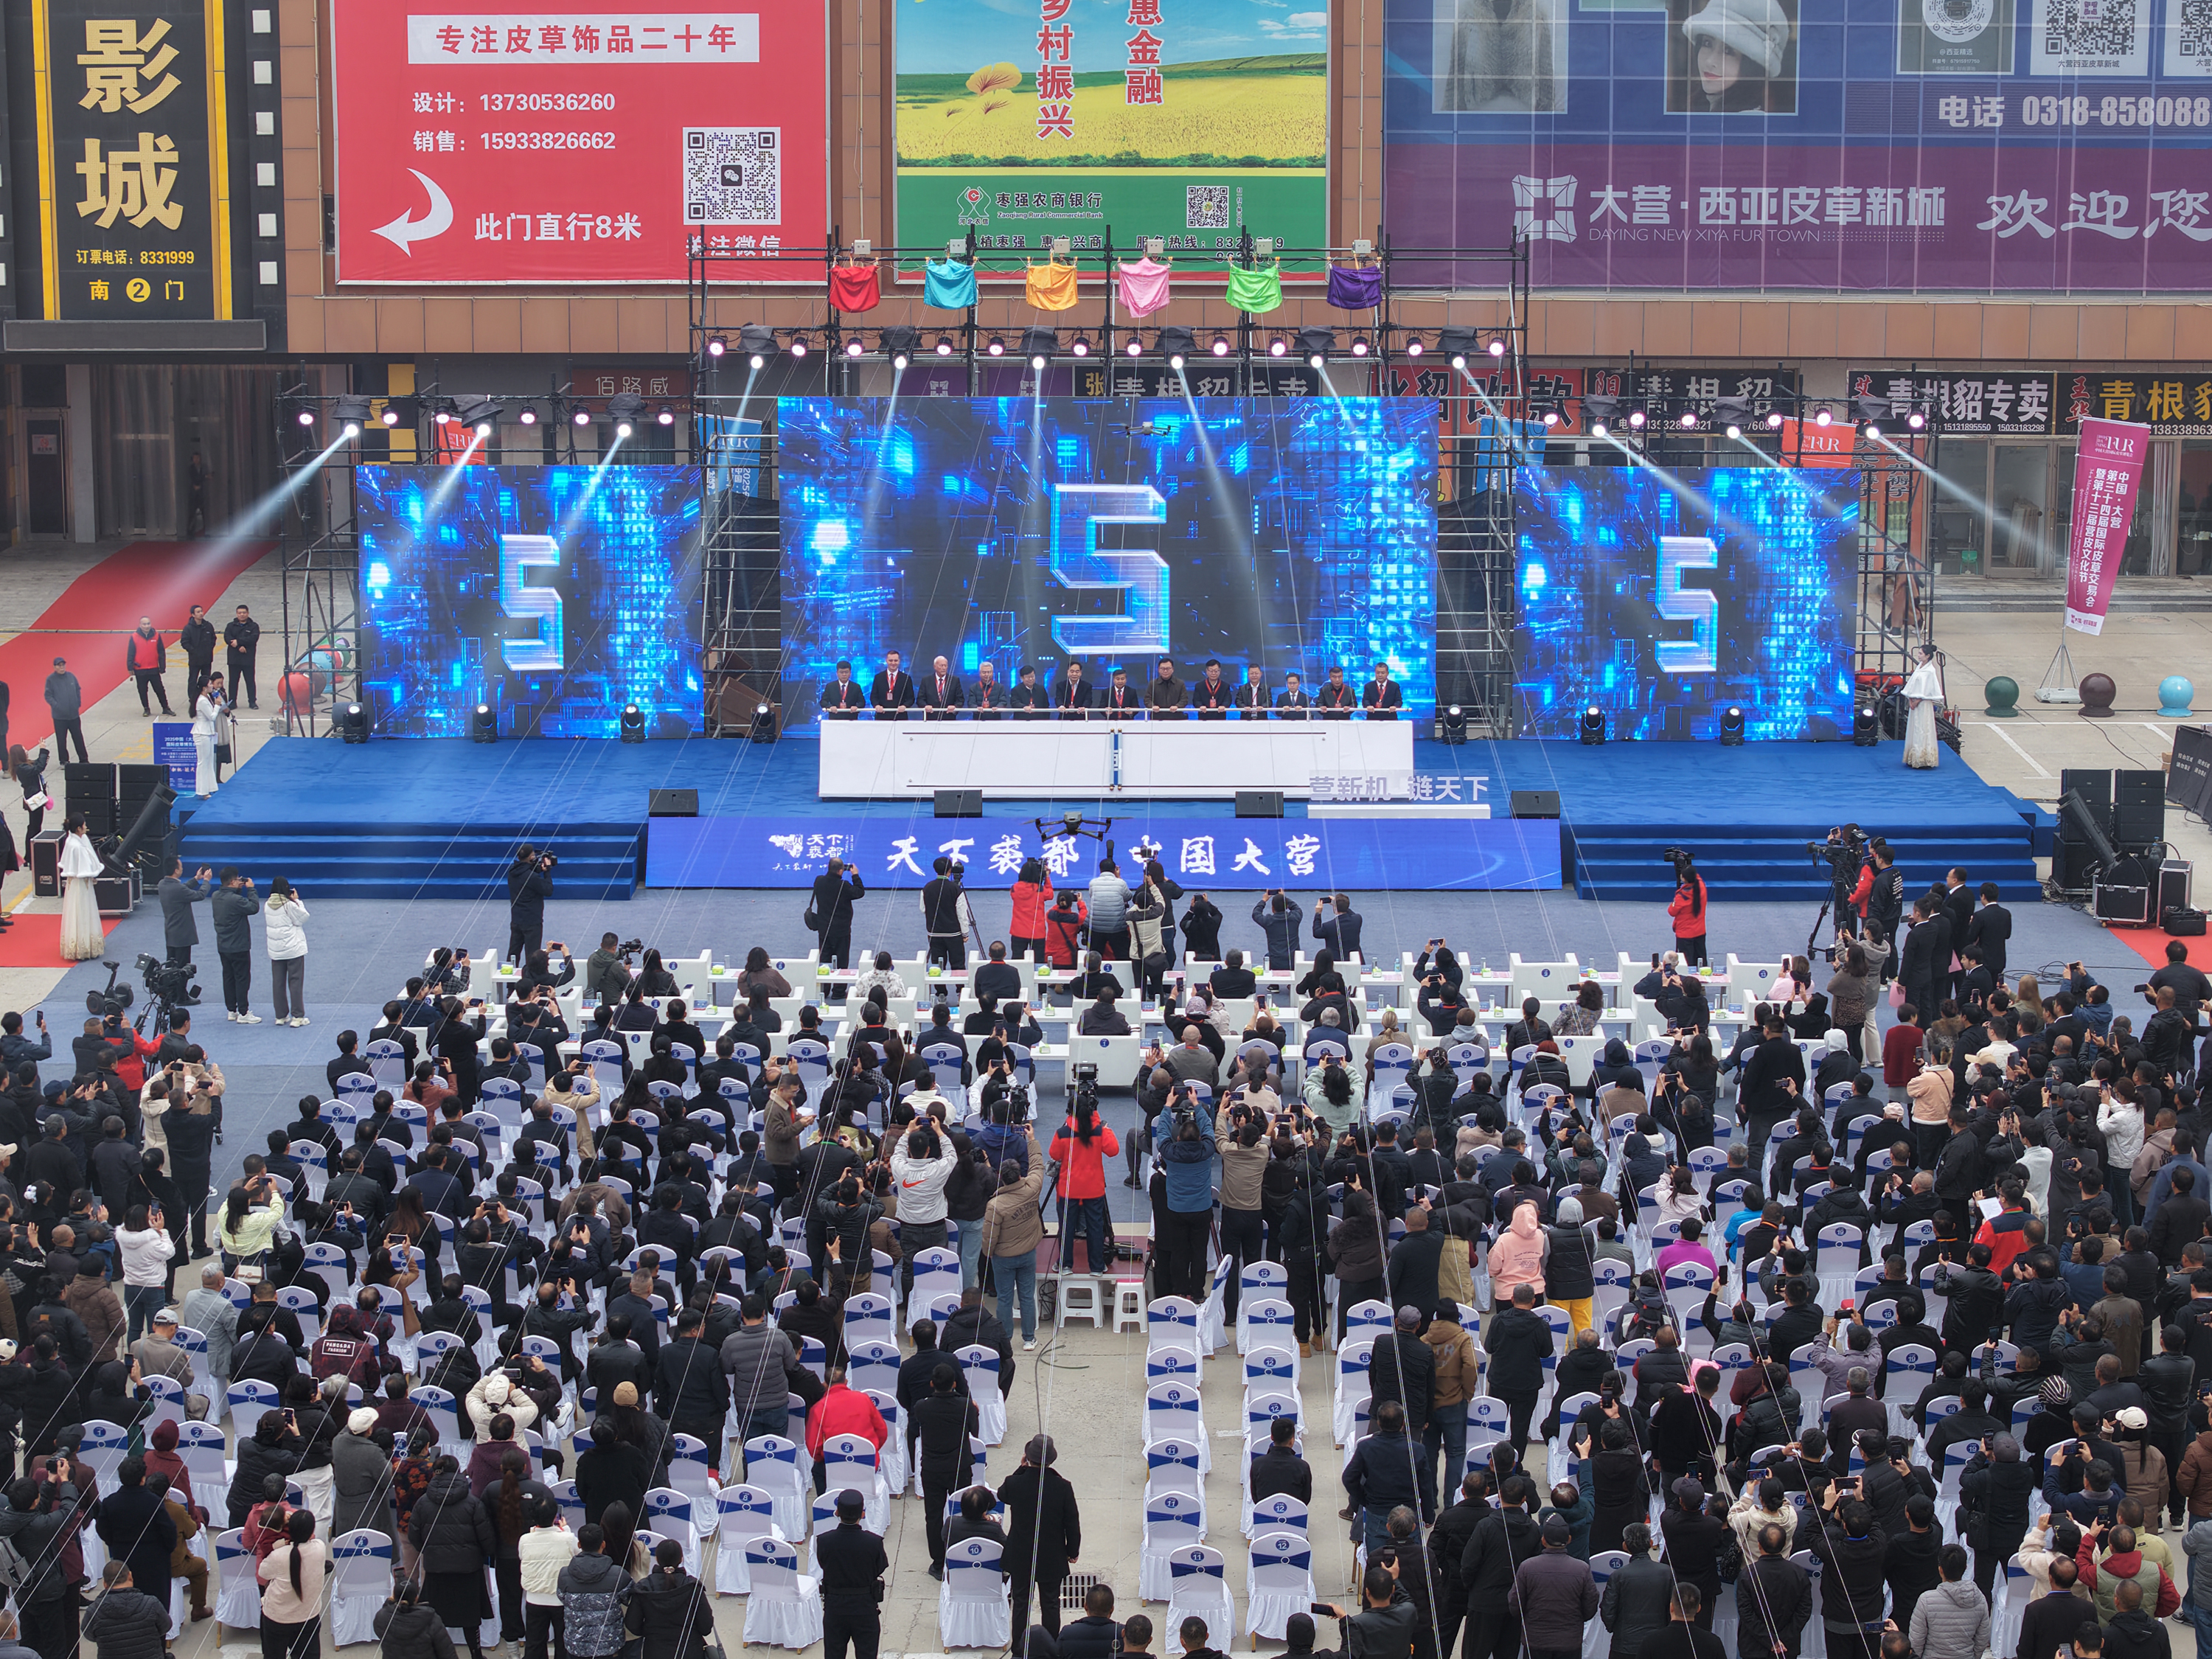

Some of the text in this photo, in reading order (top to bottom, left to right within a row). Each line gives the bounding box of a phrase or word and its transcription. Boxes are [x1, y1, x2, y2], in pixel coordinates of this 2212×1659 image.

[436, 24, 737, 54] 专注皮草饰品二十年
[2058, 60, 2120, 68] 大营西亚皮草新城
[76, 18, 184, 230] 影城
[1938, 95, 2005, 128] 电话
[996, 192, 1102, 208] 枣强农商银行
[474, 212, 642, 242] 此门直行8米
[1589, 229, 1820, 242] DAYING NEW XIYA FUR TOWN
[1040, 234, 1102, 248] 惠兴商
[595, 376, 668, 395] 佰路威
[1944, 423, 1992, 431] 15131895550
[1997, 423, 2045, 432] 15033183298
[2085, 470, 2118, 607] 第三十四届国际皮草交易会
[1049, 483, 1171, 655] 5
[499, 535, 564, 671] 5
[1655, 535, 1719, 672] 5
[1406, 776, 1489, 801] 链天下
[907, 1170, 926, 1180] NIKE
